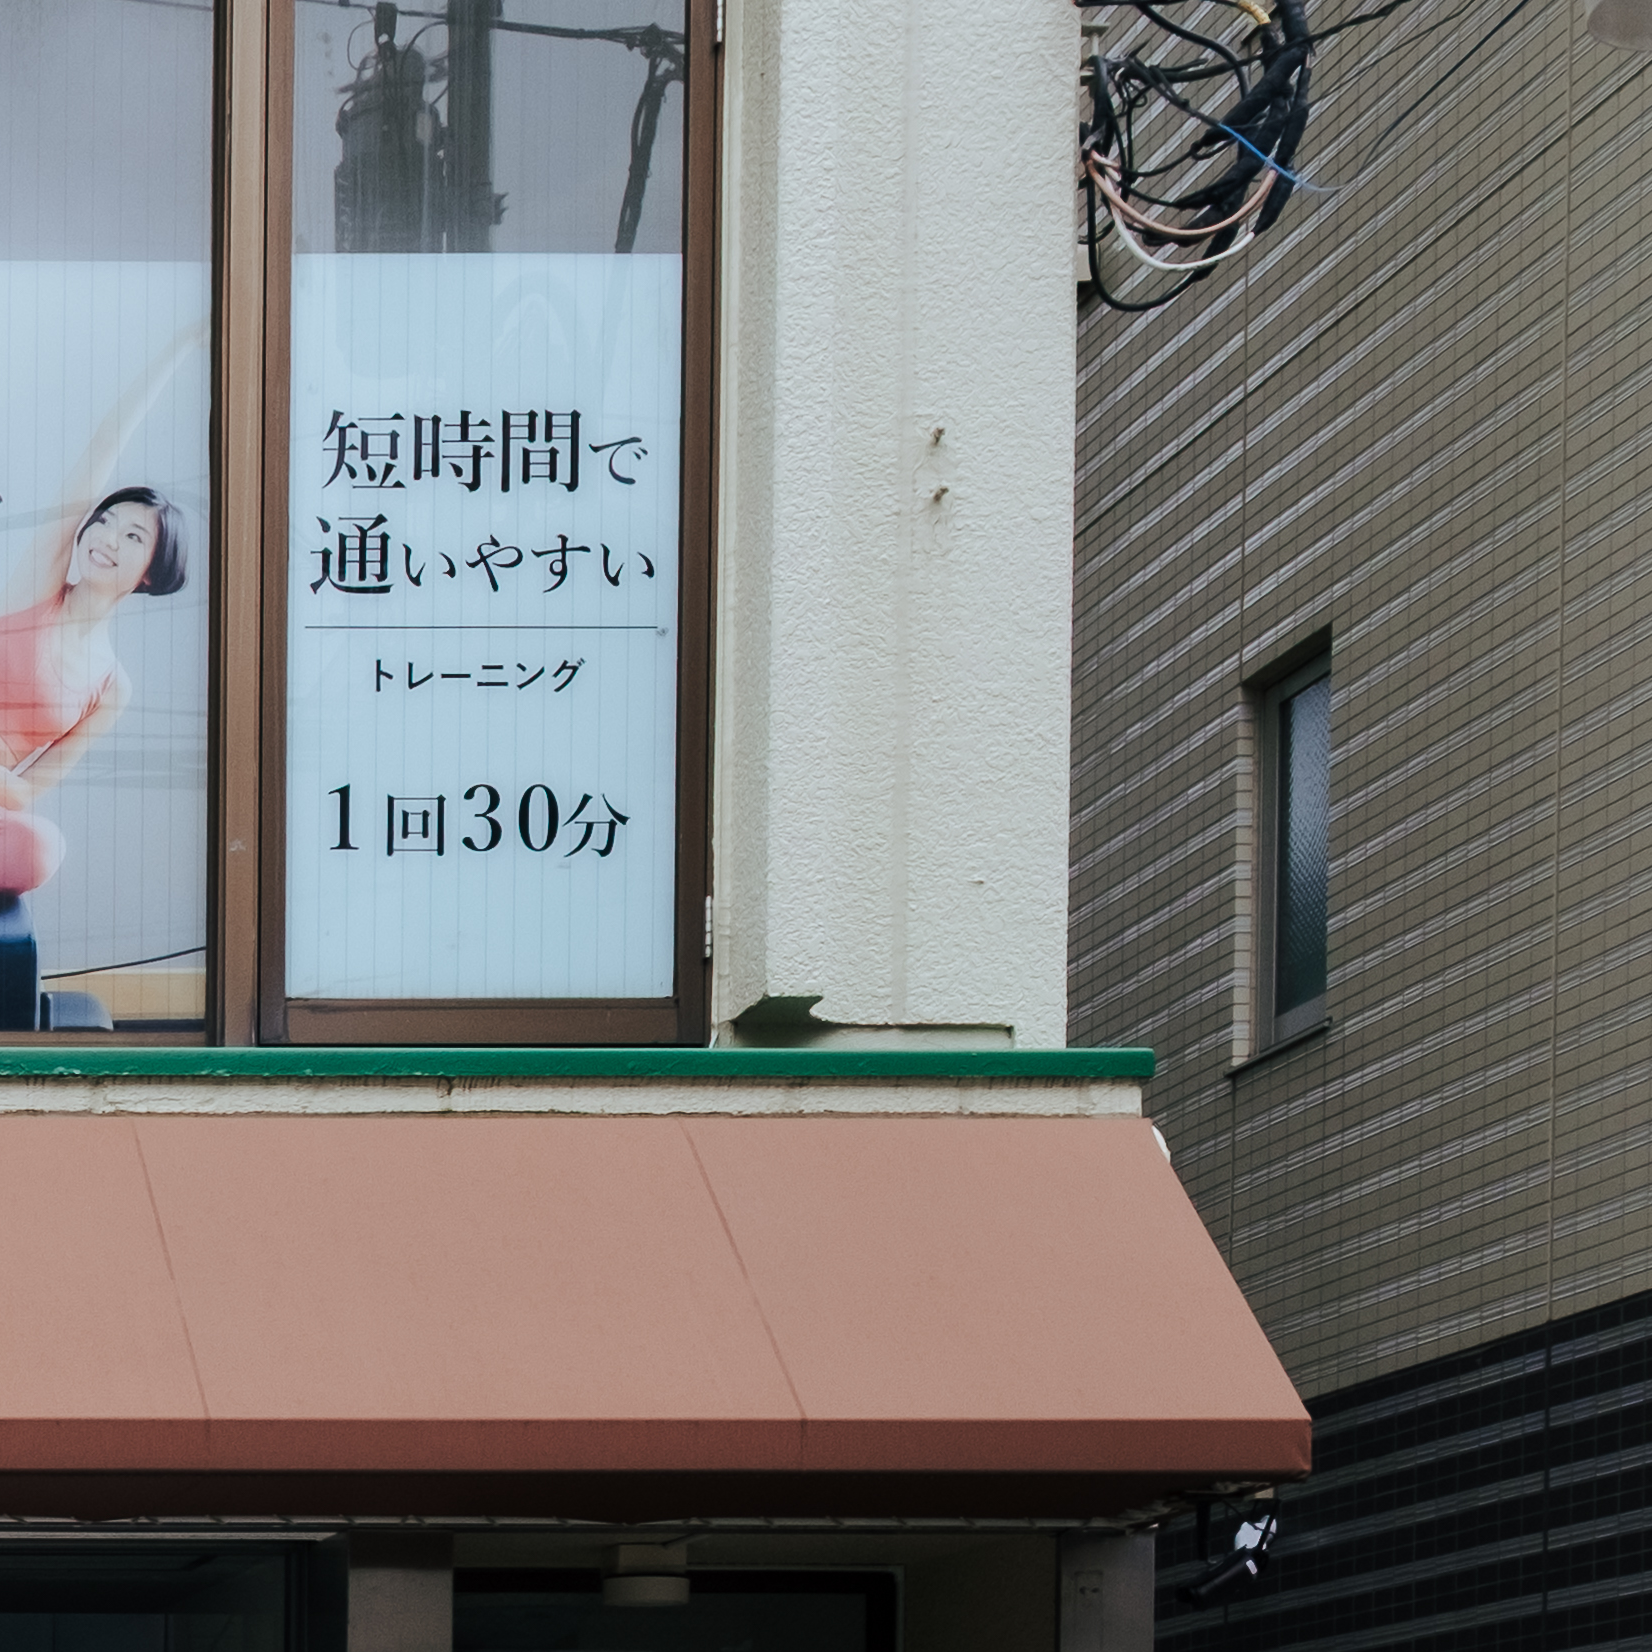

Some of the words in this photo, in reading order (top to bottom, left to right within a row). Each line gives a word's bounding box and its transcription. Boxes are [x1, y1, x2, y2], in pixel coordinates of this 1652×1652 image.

[323, 410, 648, 492] 短時間で
[310, 514, 654, 594] 通いやすい
[376, 658, 585, 692] トレーニング
[329, 784, 630, 857] 1回30分
